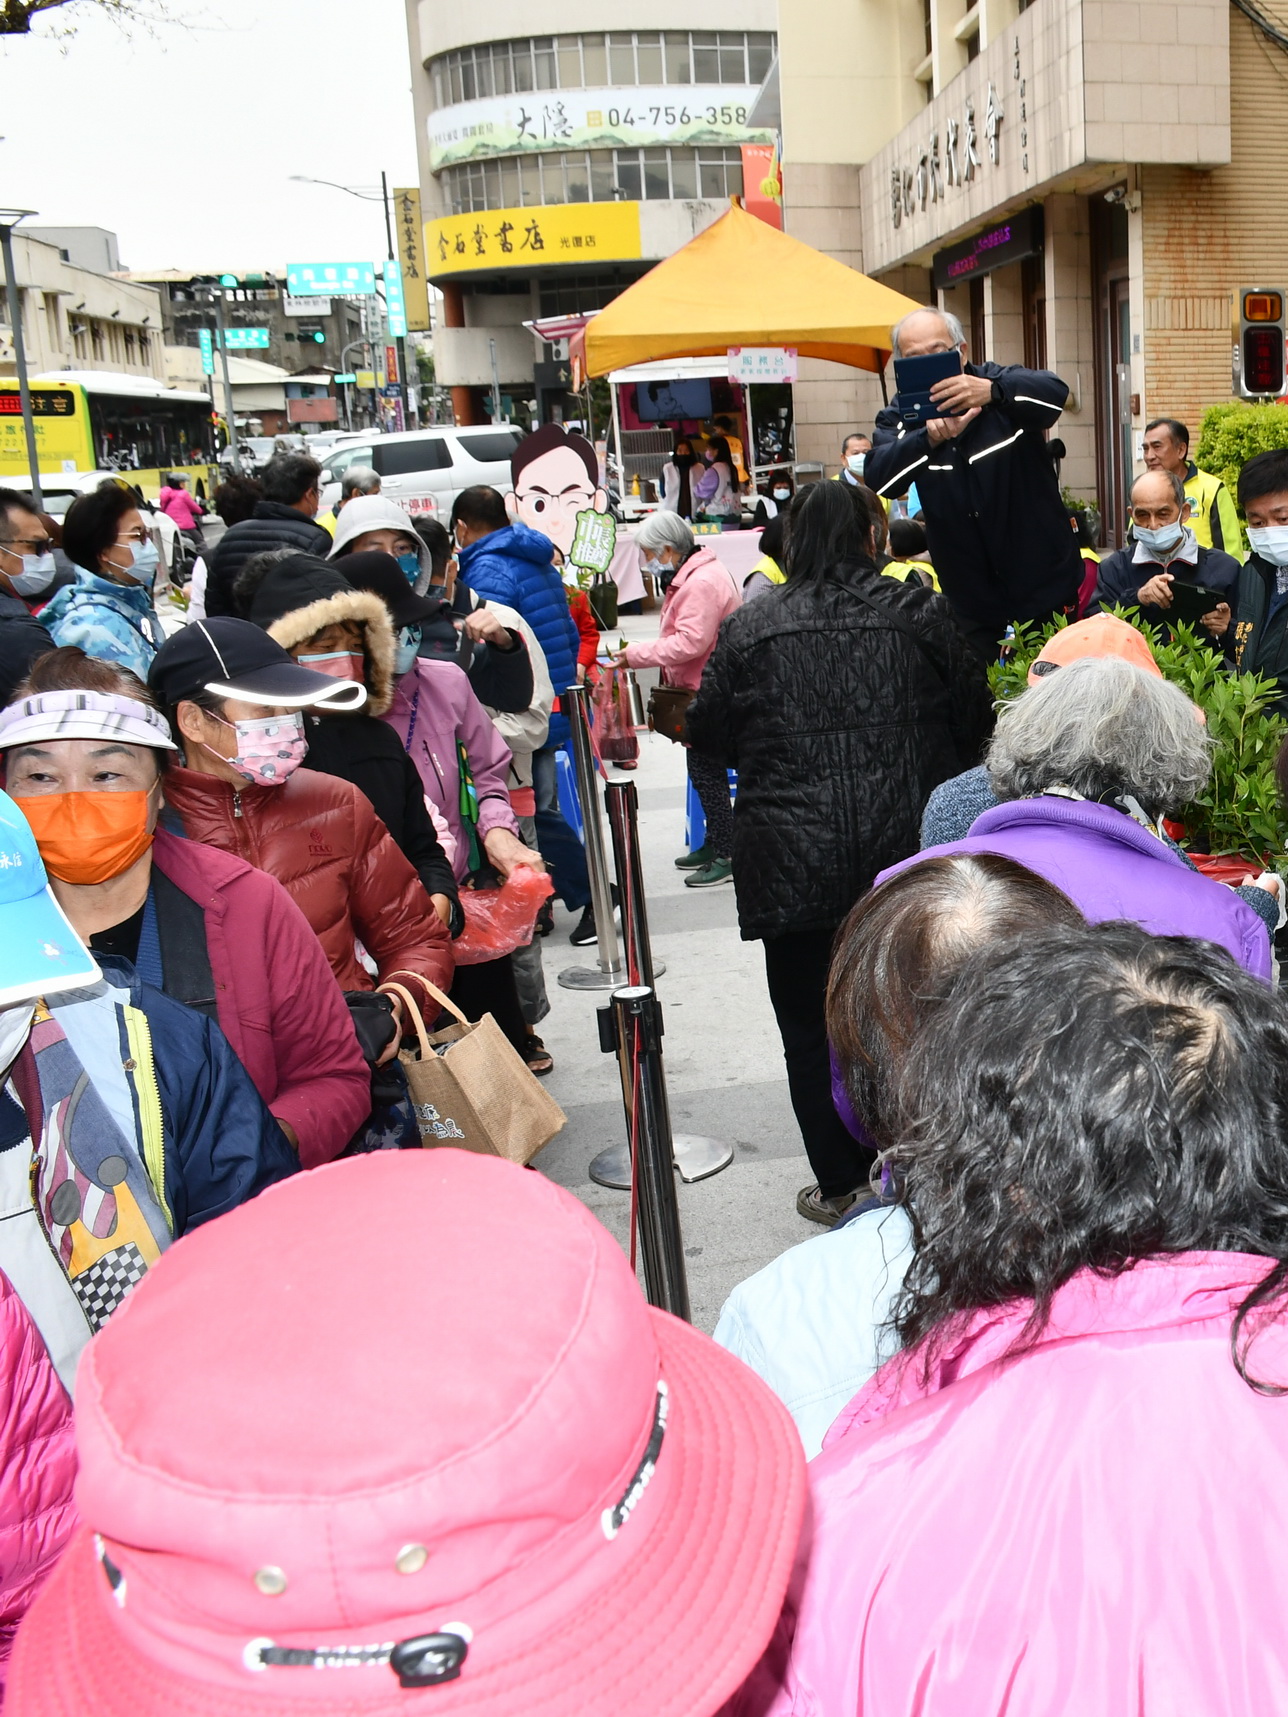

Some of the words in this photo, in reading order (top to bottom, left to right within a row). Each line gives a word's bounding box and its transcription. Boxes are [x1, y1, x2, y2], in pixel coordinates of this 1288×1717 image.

[608, 106, 746, 127] 04-756-358
[400, 191, 419, 279] 金石堂書店
[437, 218, 545, 262] 金石堂書店
